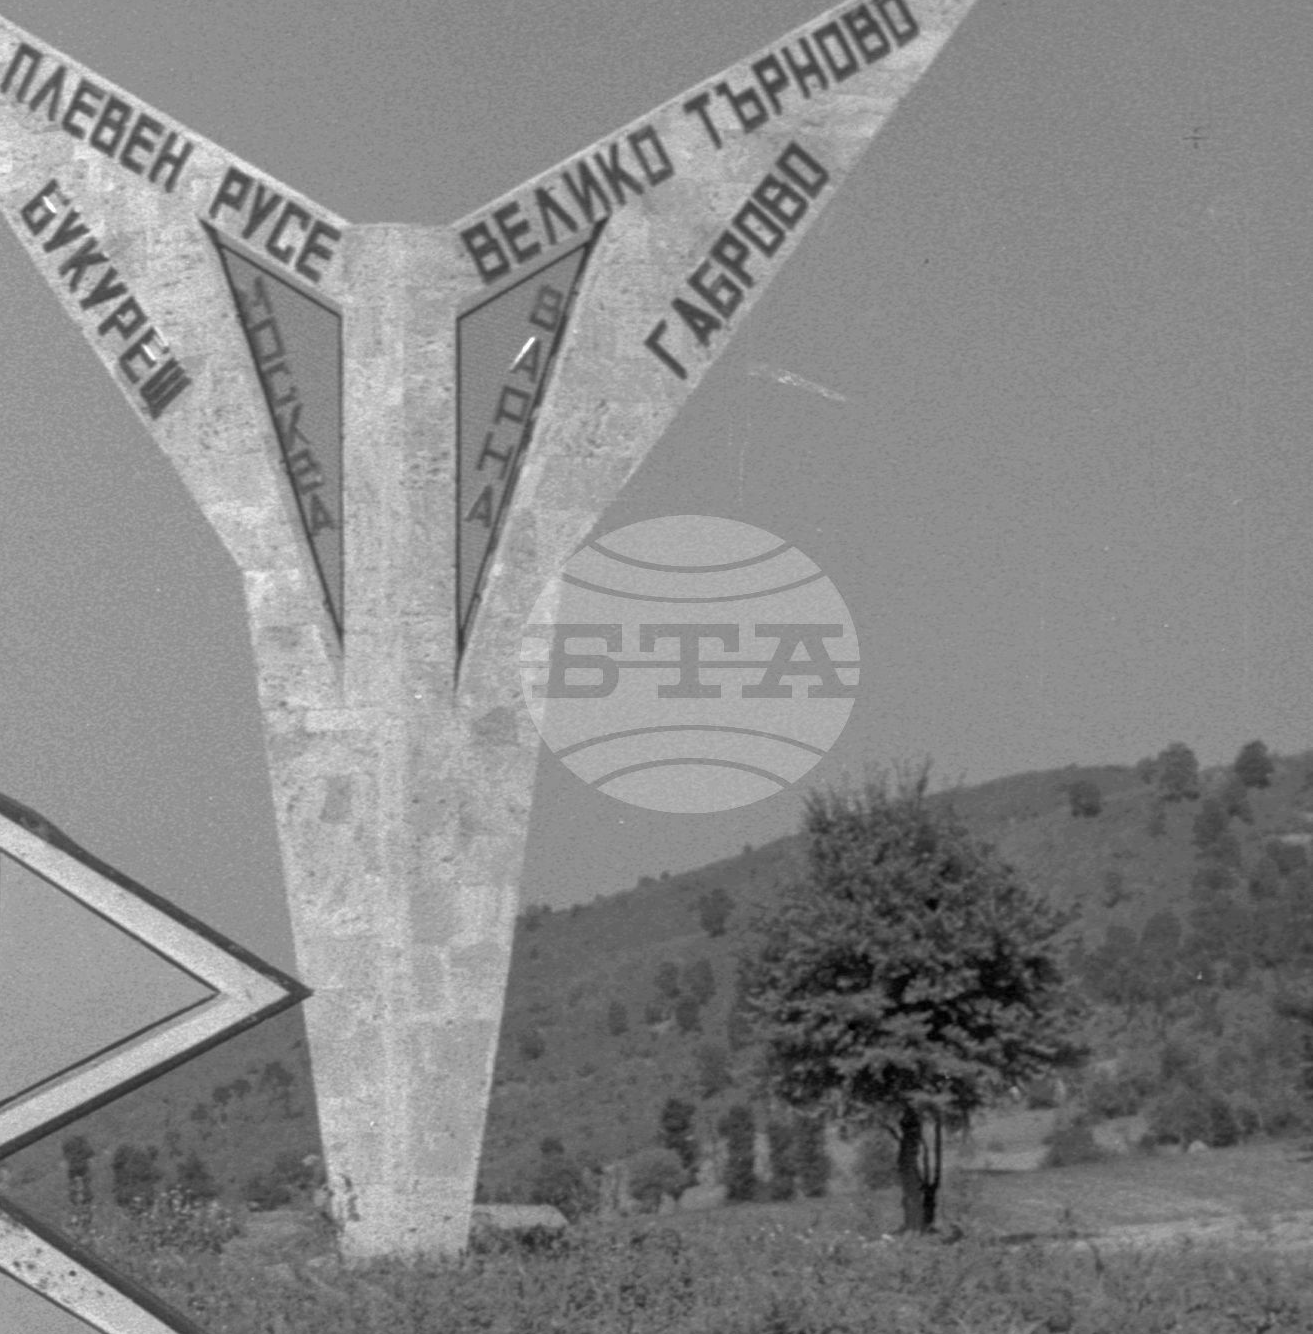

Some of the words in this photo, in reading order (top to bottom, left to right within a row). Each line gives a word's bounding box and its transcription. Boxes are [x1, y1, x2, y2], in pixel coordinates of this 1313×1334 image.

[0, 43, 194, 193] ПЛЕВЕН
[207, 167, 342, 283] РУСЕ
[460, 123, 675, 285] ВЕЛИКО
[643, 141, 831, 380] ГАБРОВО
